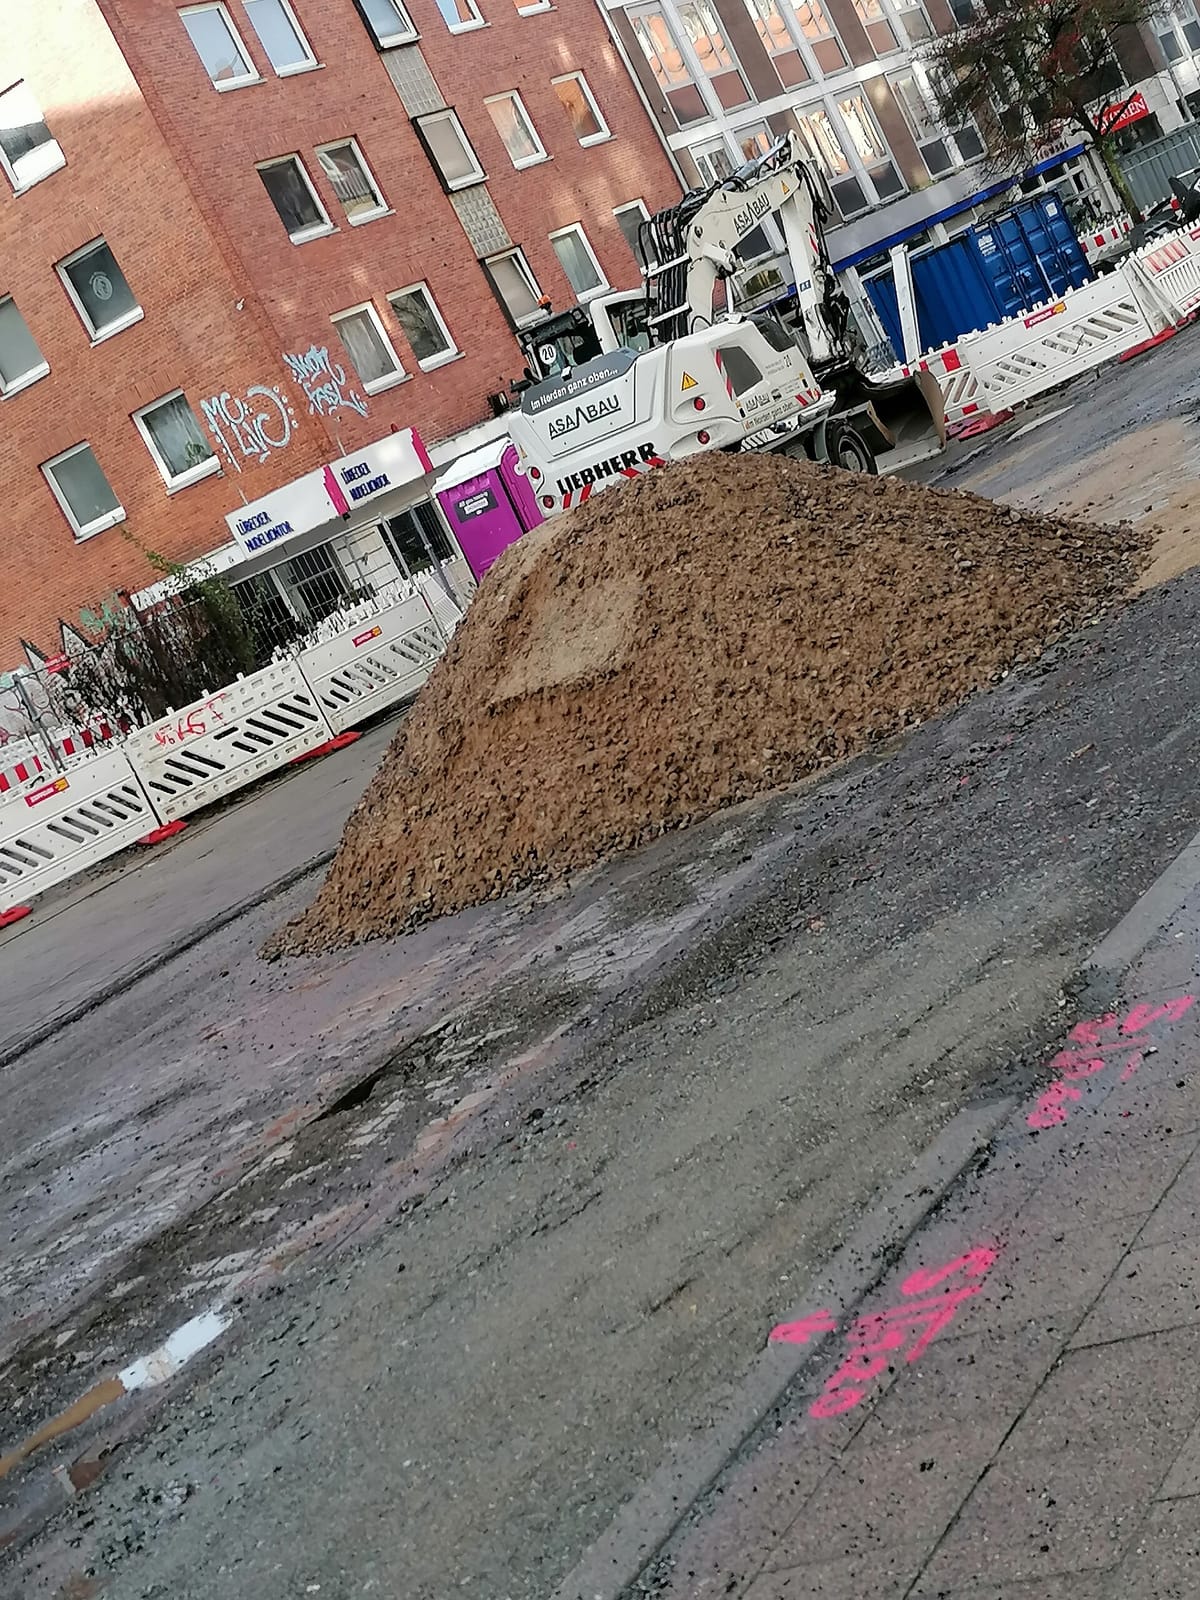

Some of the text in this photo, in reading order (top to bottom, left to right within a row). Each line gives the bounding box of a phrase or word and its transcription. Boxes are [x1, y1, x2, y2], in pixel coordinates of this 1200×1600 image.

[752, 192, 770, 216] BAU
[542, 346, 555, 361] 20
[539, 386, 567, 405] Norden
[566, 377, 587, 394] ganz
[588, 395, 619, 418] BAU
[557, 442, 657, 494] LIEBHERR
